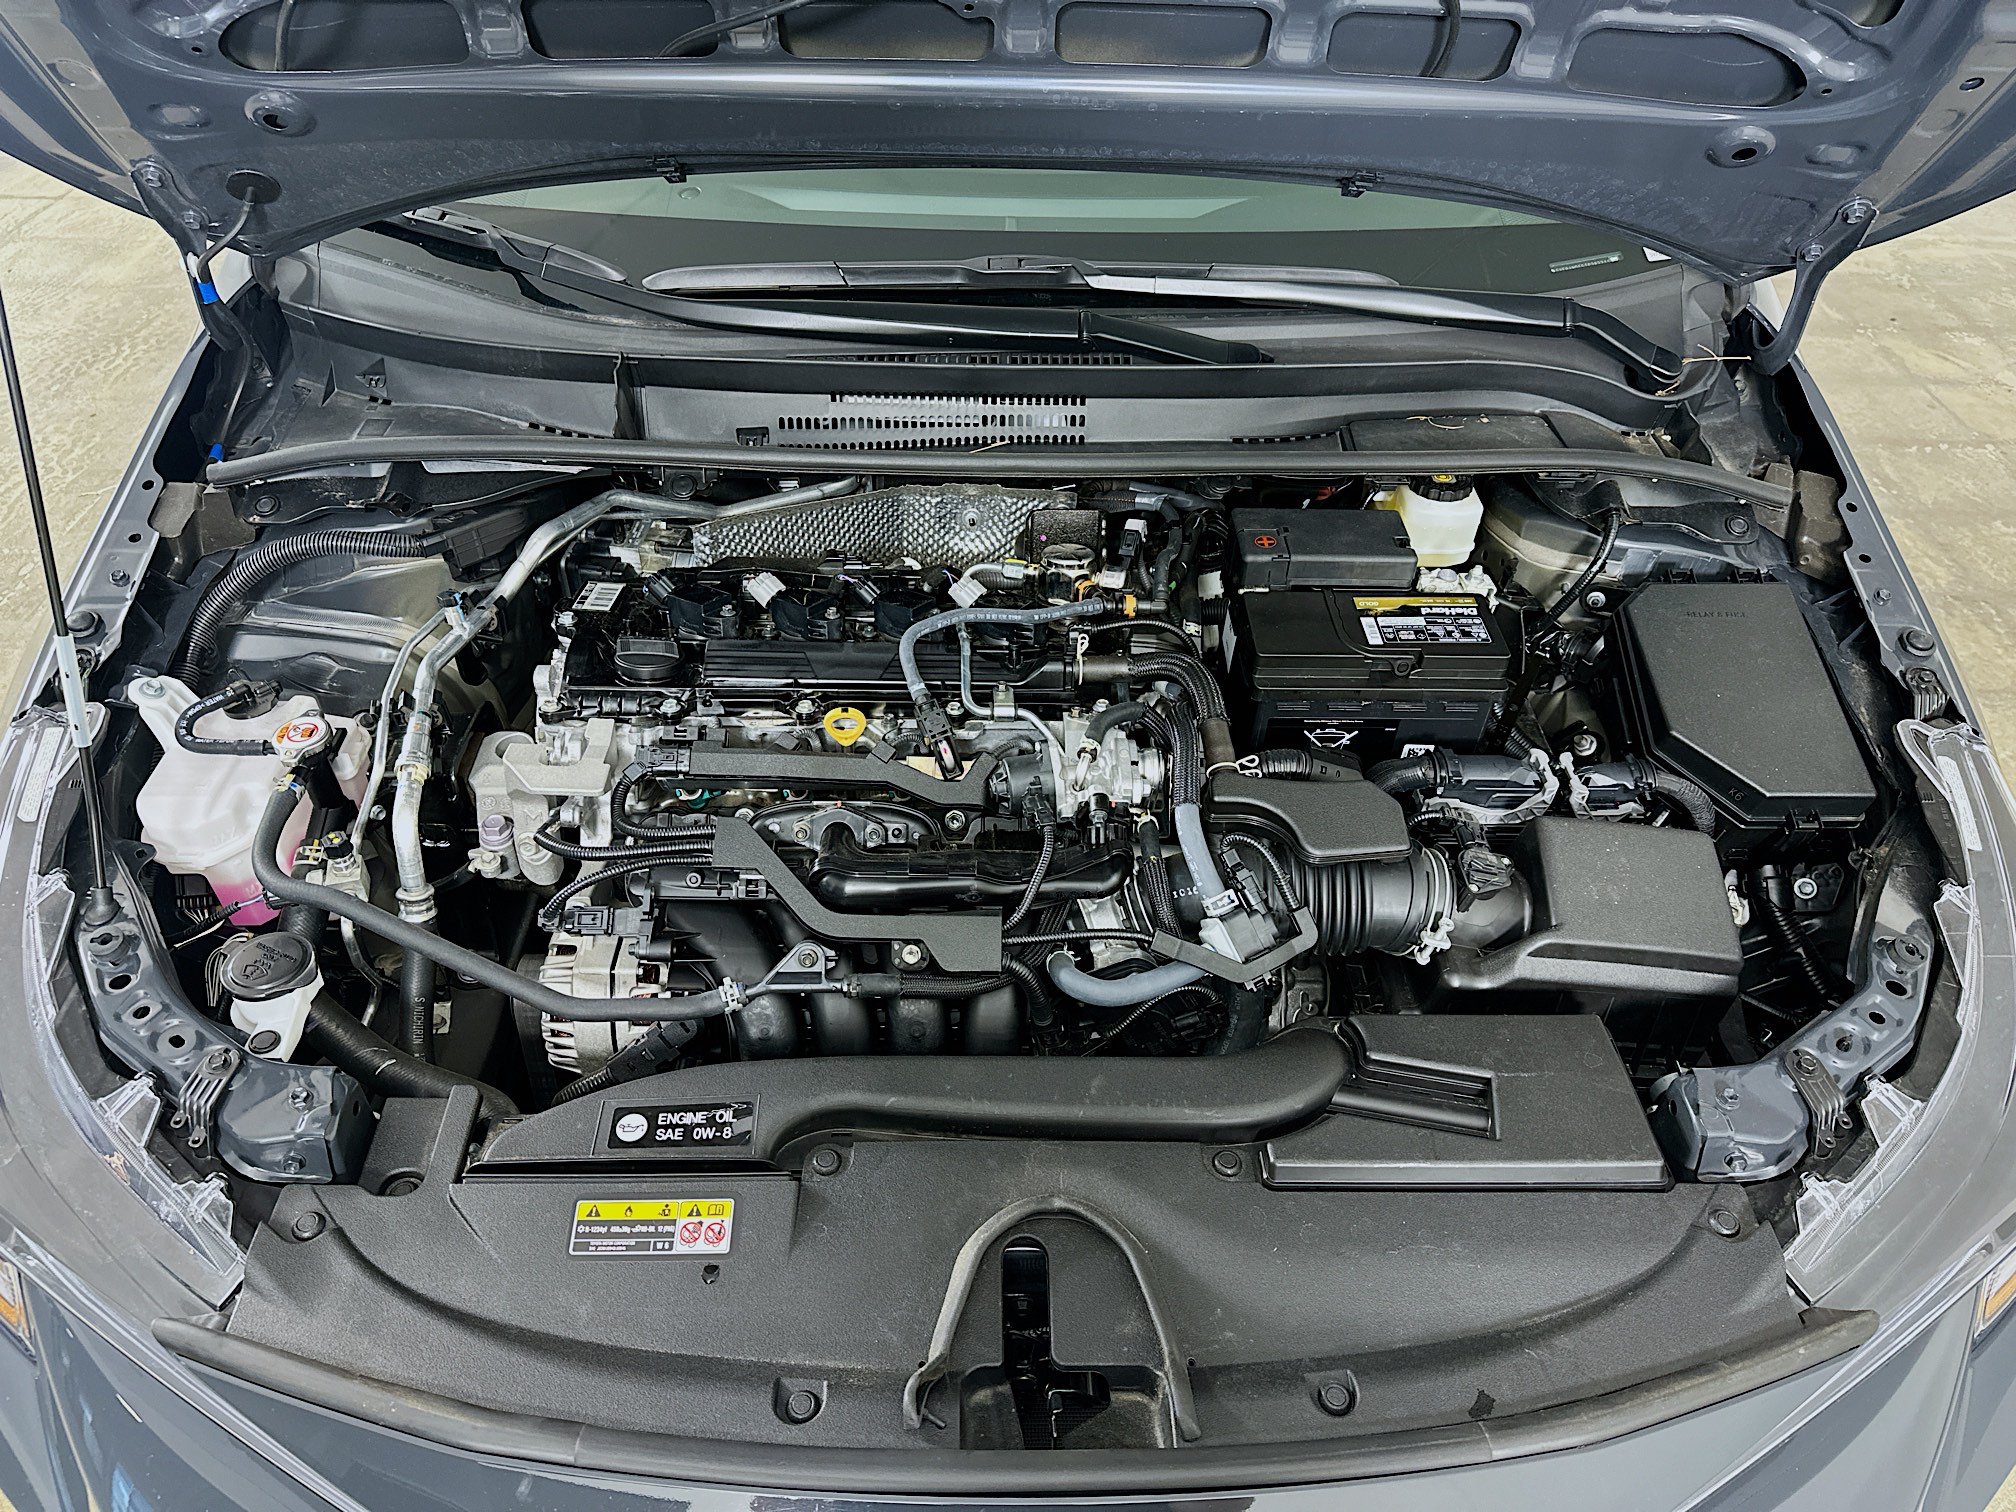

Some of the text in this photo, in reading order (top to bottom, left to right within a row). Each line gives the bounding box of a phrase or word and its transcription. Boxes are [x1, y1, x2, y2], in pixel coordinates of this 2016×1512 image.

[1421, 607, 1478, 616] DieHard
[1728, 787, 1744, 801] K6
[412, 1006, 425, 1044] NICHIRIN
[657, 1110, 737, 1125] ENGINE OIL
[655, 1126, 732, 1141] SAE 0W-8
